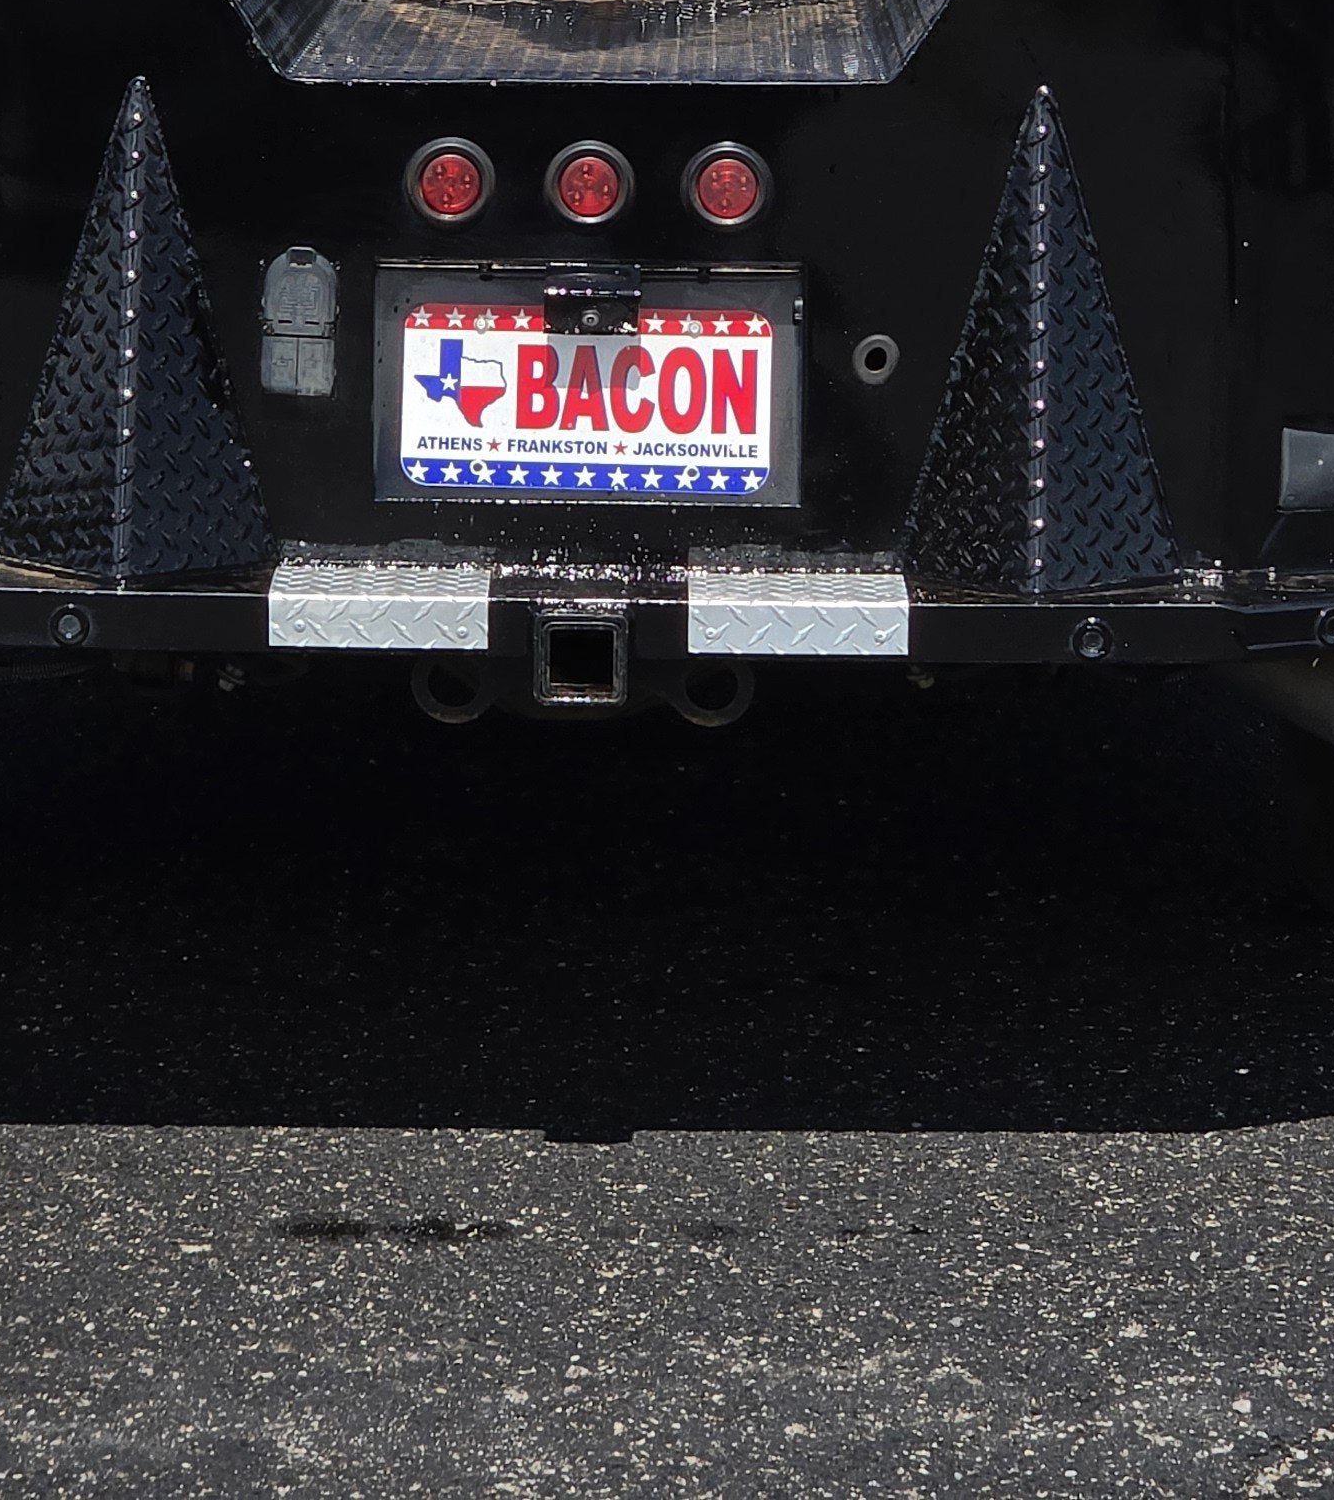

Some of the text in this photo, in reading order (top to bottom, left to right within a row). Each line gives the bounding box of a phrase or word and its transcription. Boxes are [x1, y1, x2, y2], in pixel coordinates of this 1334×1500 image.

[515, 343, 758, 435] BACON
[417, 436, 758, 459] ATHENS FRANKSTON JACKSONVILLE
